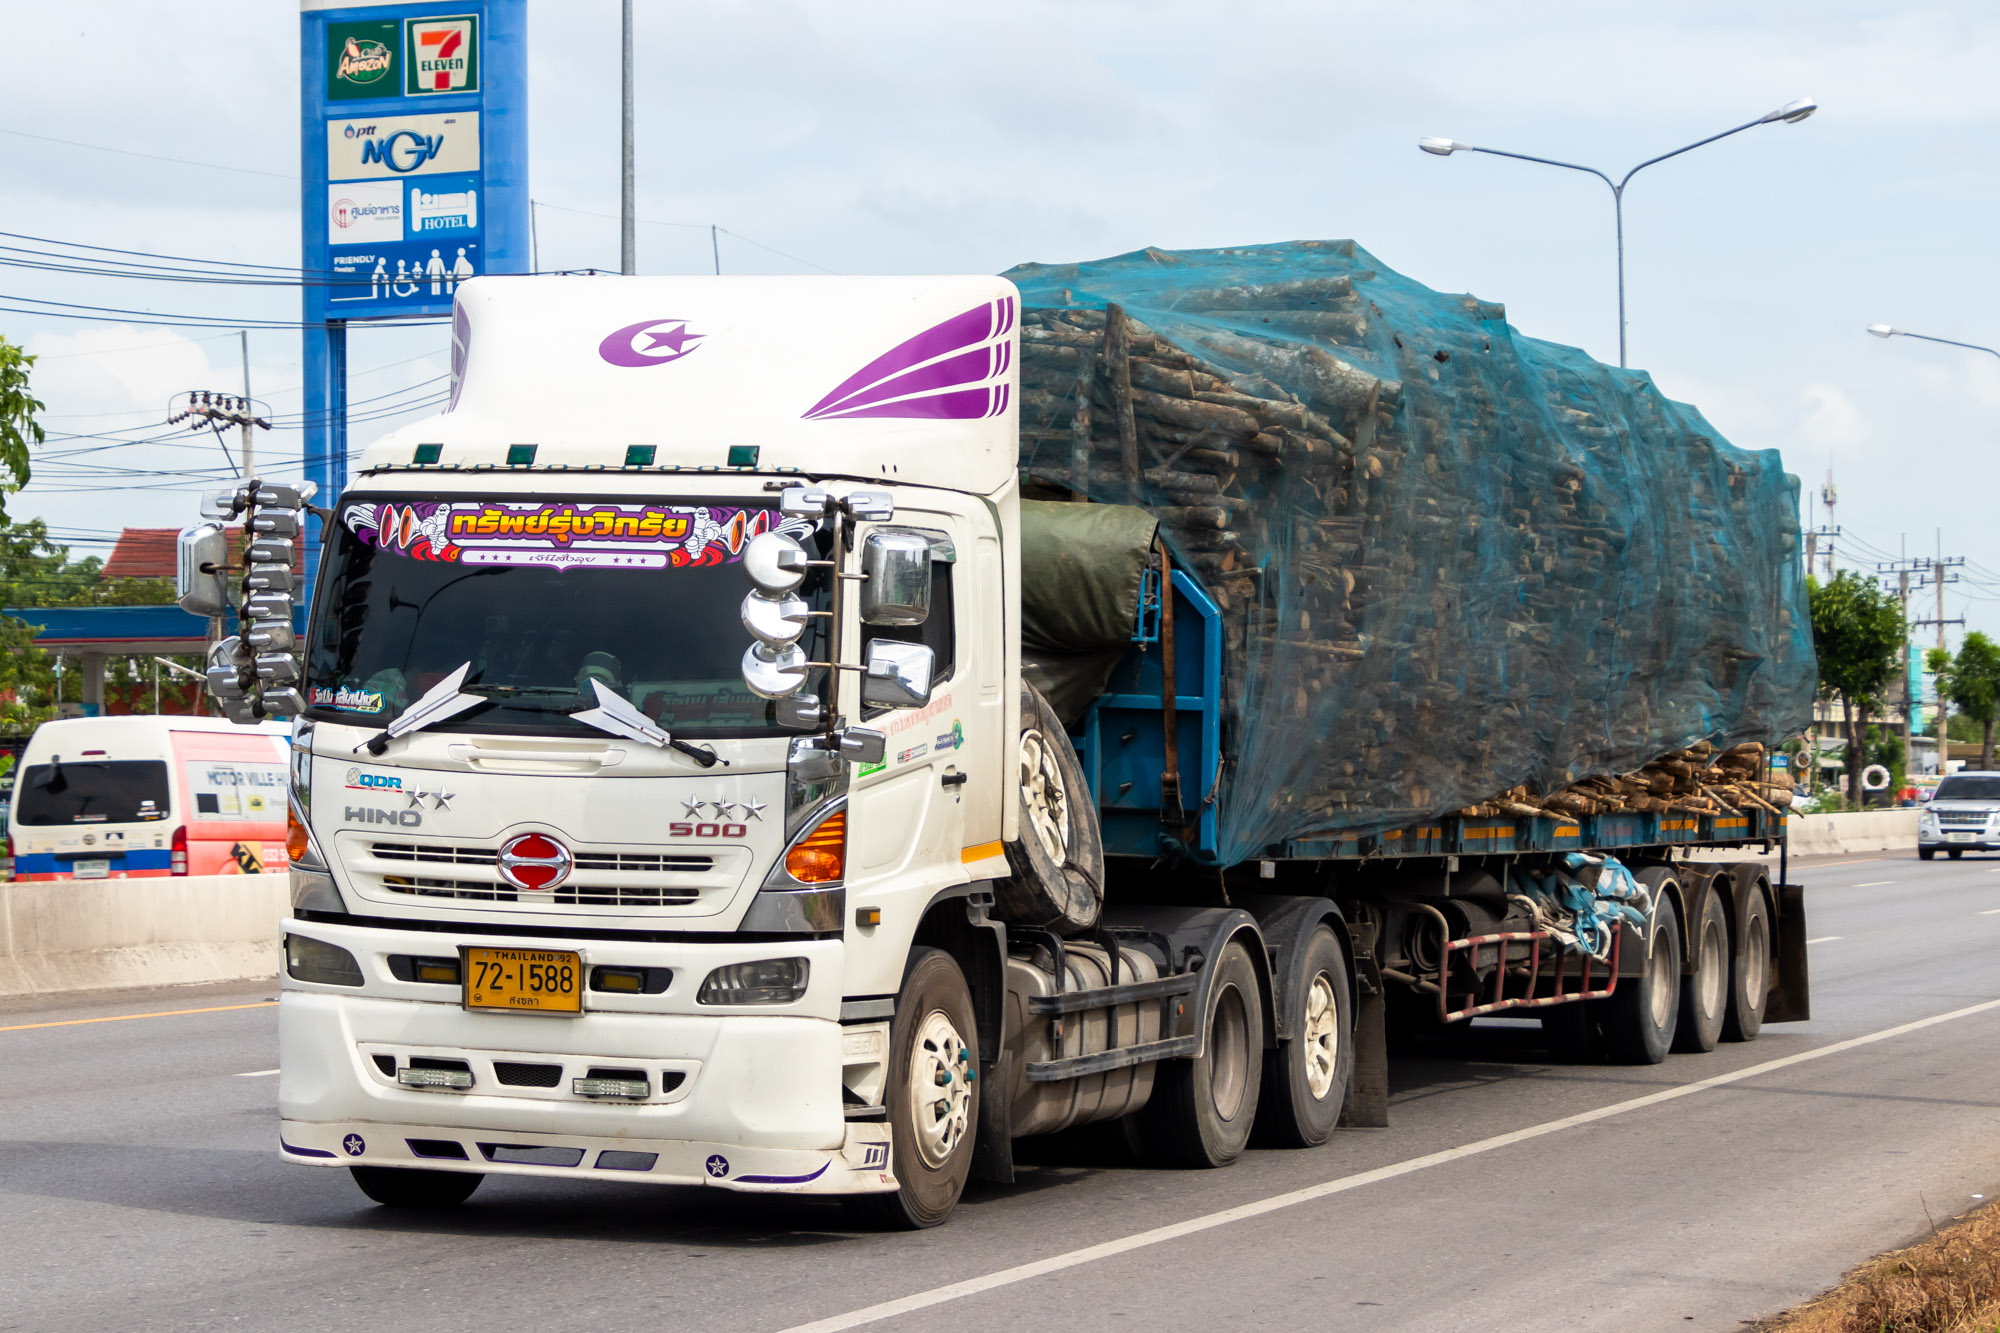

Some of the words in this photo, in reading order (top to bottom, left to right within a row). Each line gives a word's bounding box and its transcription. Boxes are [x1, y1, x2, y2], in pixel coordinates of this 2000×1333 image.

[421, 29, 462, 89] 7
[356, 125, 377, 138] ptt
[361, 129, 444, 173] NGV
[351, 203, 400, 220] ศูนย์อาหาร
[424, 216, 466, 230] HOTEL
[334, 255, 376, 266] FRIENDLY
[207, 771, 245, 786] MOTOR
[360, 774, 402, 789] QDR
[344, 805, 422, 827] HINO
[669, 822, 747, 838] 500
[494, 951, 554, 962] THAILAND
[475, 961, 573, 993] 72-1588
[509, 996, 540, 1006] สงขลา
